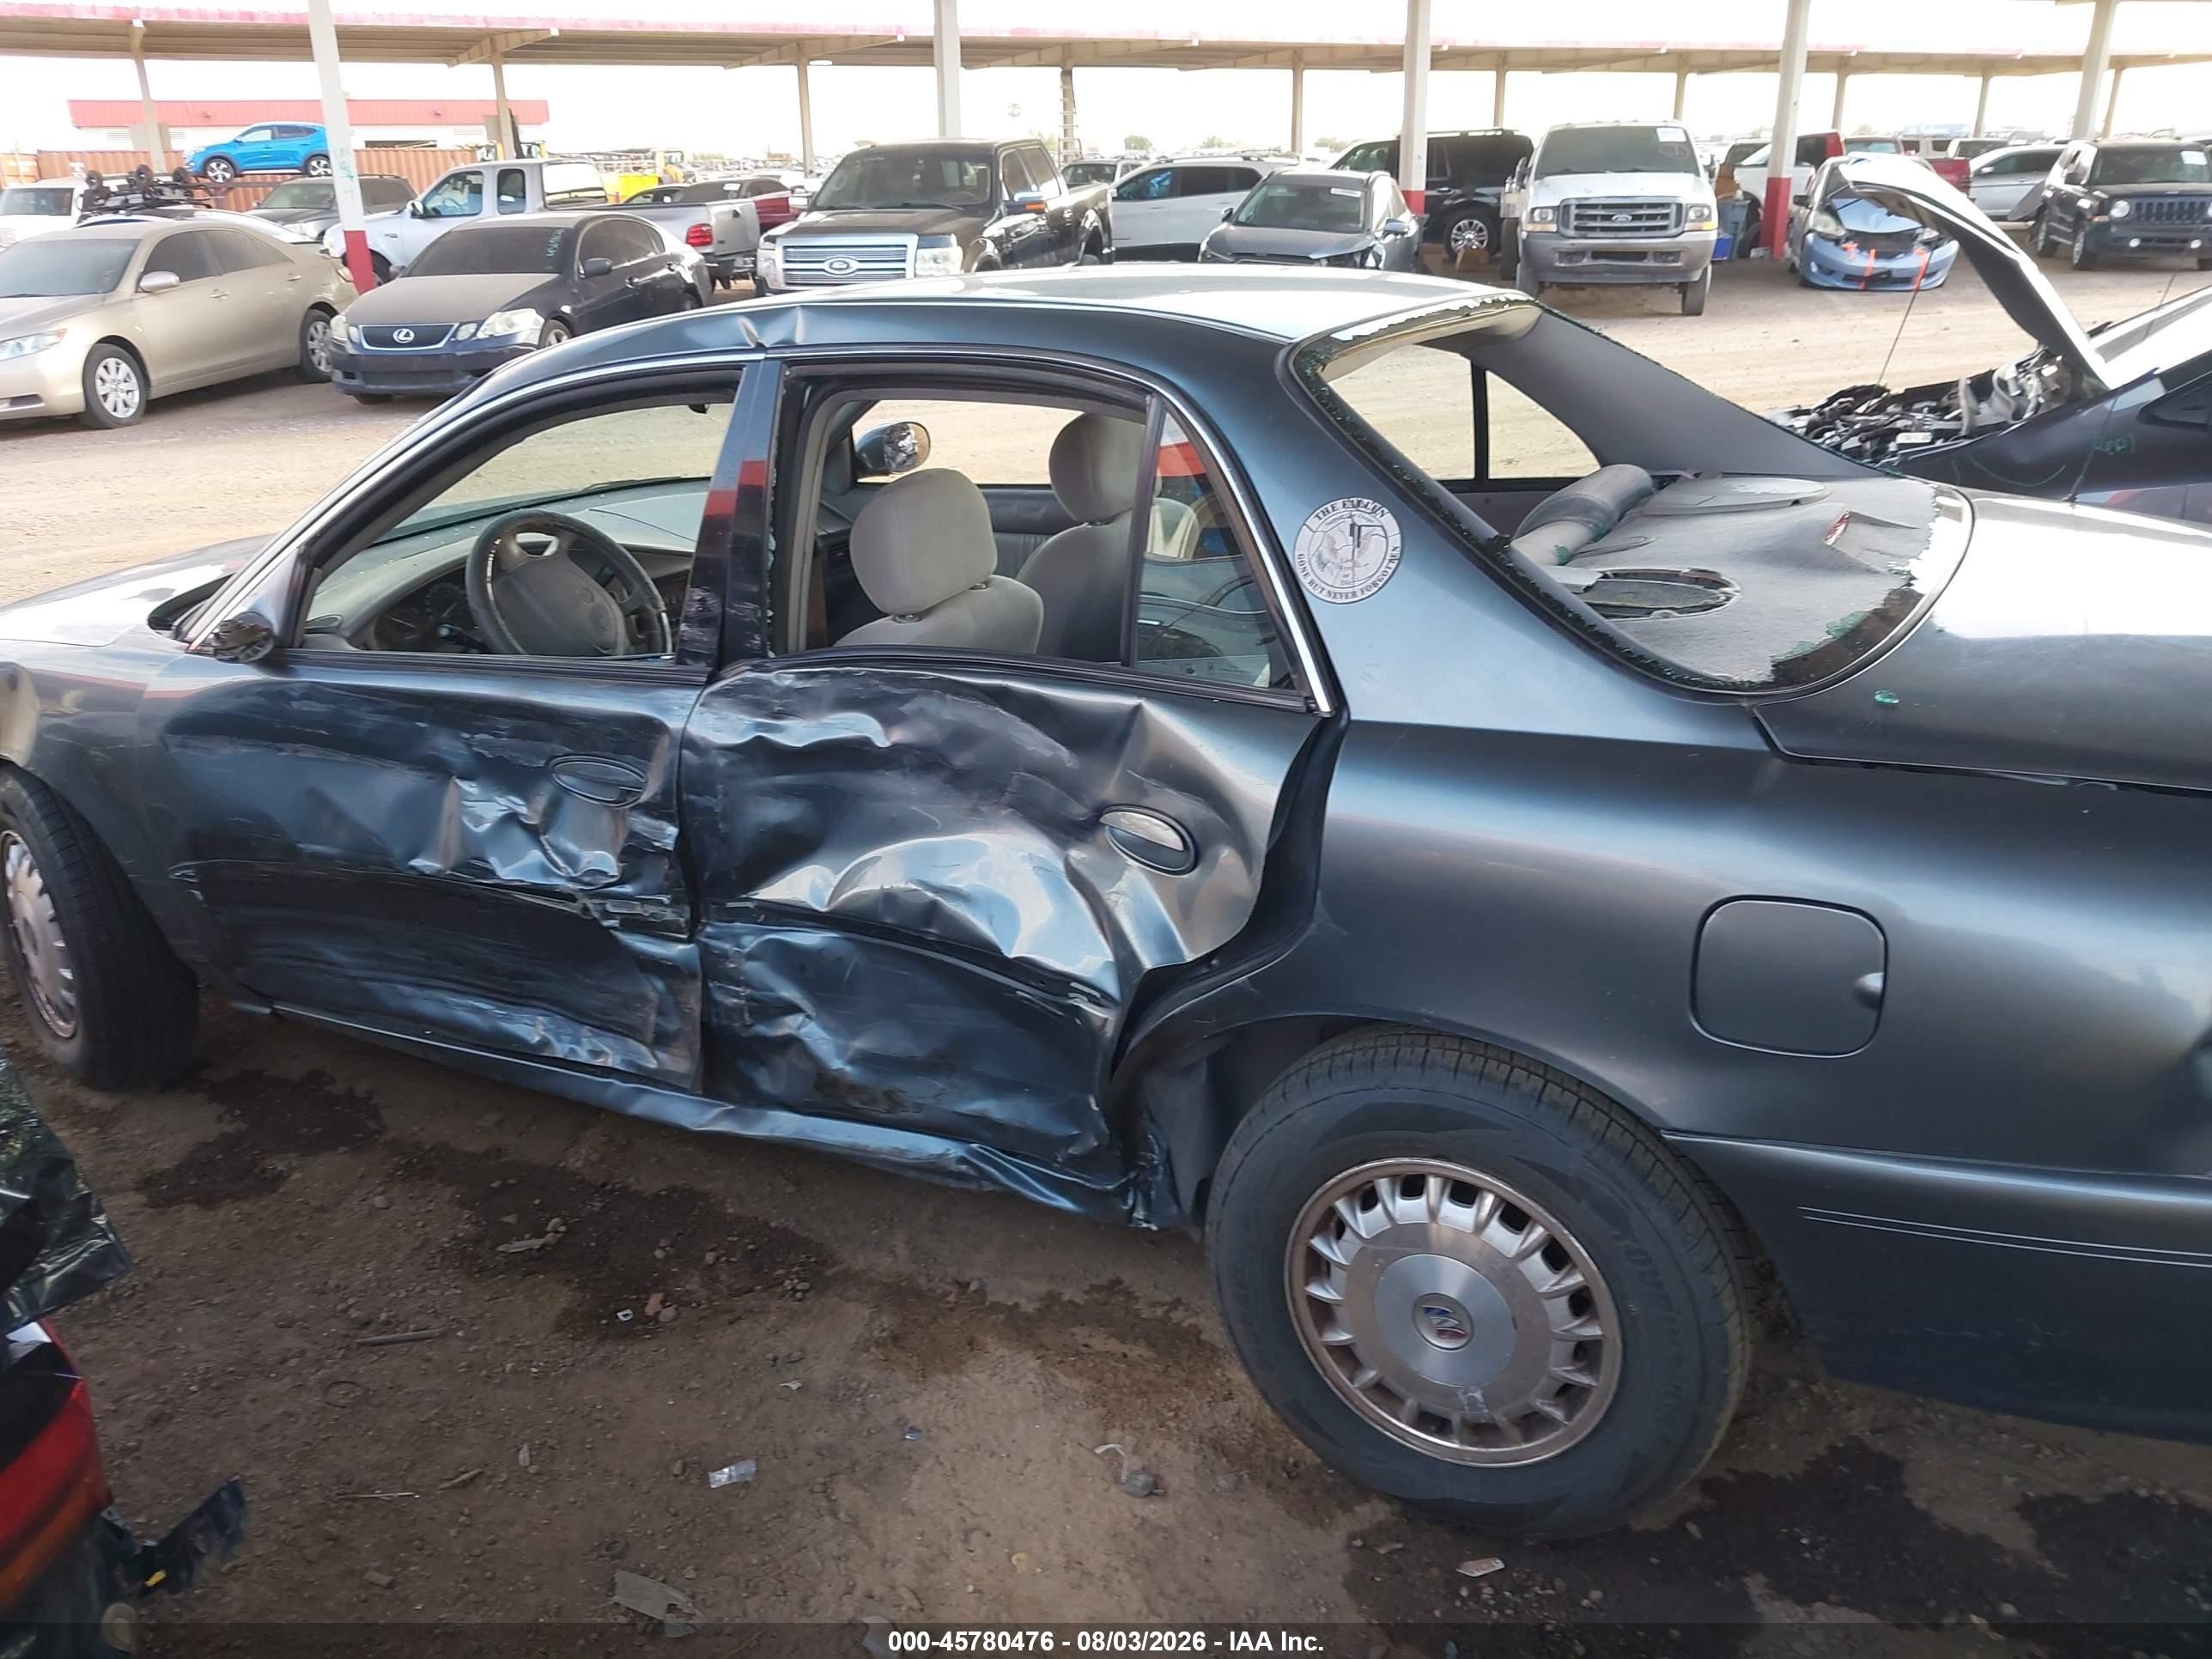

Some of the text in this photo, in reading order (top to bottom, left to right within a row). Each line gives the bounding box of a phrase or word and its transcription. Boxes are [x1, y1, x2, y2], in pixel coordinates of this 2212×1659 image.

[1315, 504, 1339, 520] THE
[1297, 553, 1310, 580] GONE
[1307, 578, 1327, 594] BUT
[1326, 590, 1358, 599] NEVER
